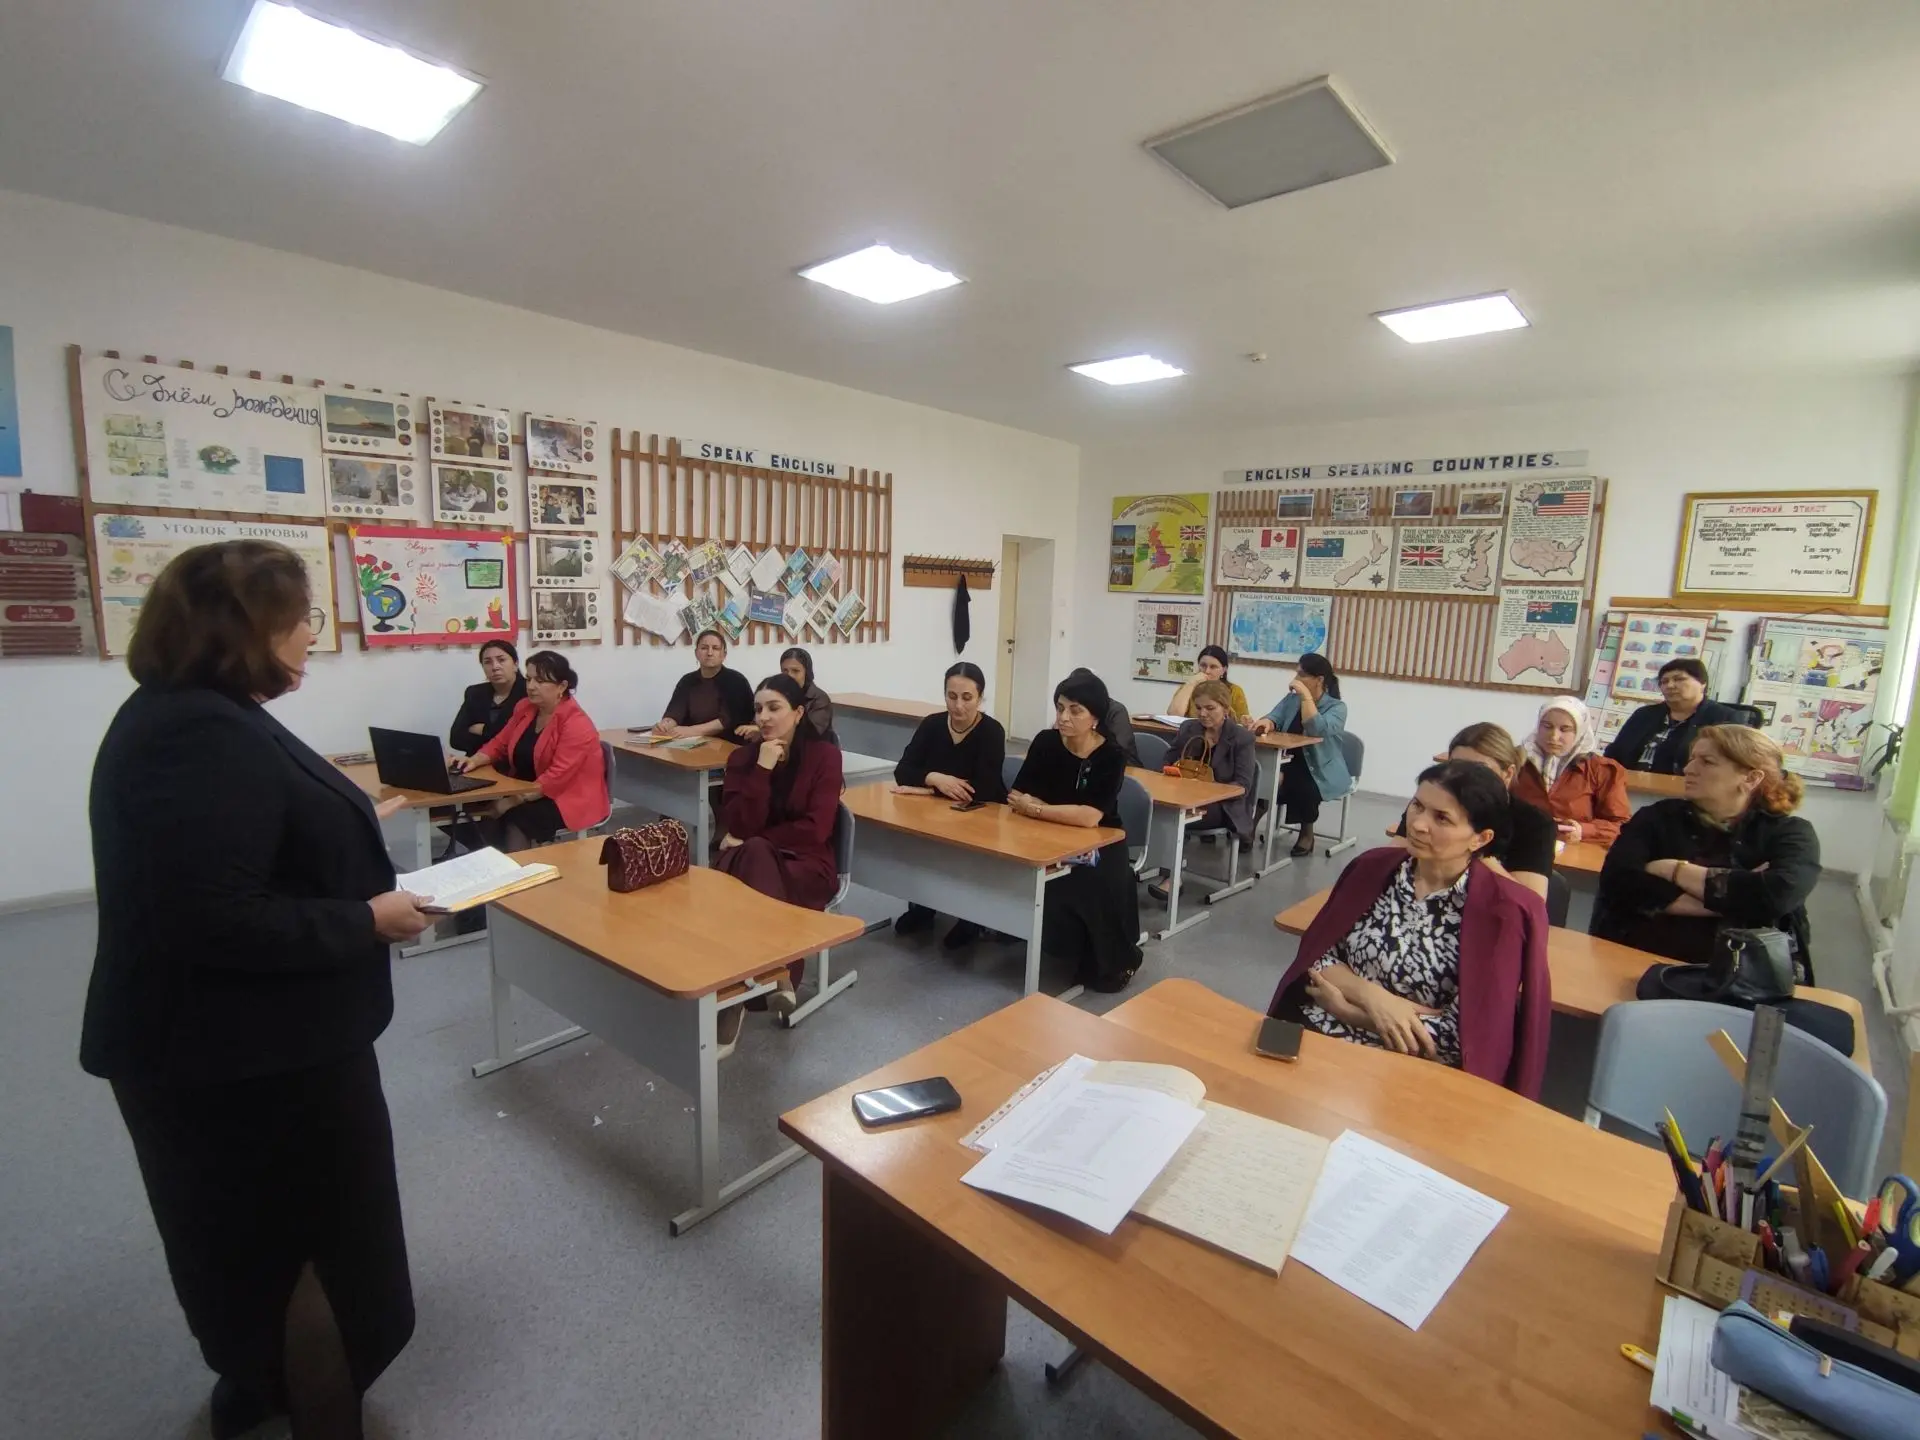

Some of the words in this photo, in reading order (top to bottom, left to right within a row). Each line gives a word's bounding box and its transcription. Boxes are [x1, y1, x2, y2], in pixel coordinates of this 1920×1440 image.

[700, 443, 754, 463] SPEAK
[771, 454, 835, 476] ENGLISH
[1245, 467, 1311, 482] ENGLISH
[1327, 461, 1414, 477] SPEAKING
[1433, 454, 1560, 472] COUNTRIES.
[162, 523, 227, 536] УГОЛОК
[239, 527, 309, 540] ЗДОРОВЬЯ
